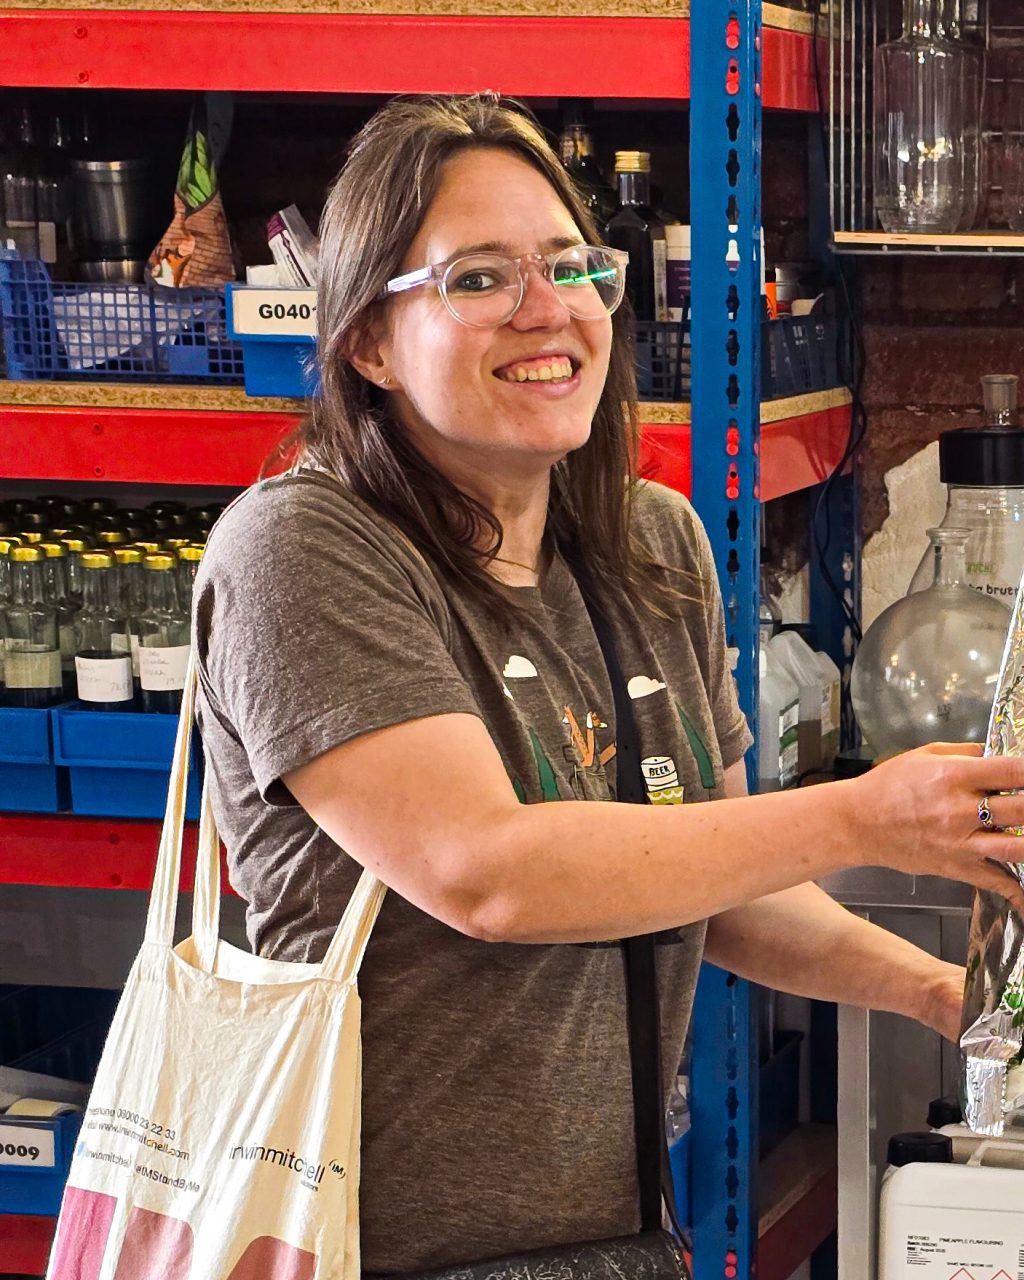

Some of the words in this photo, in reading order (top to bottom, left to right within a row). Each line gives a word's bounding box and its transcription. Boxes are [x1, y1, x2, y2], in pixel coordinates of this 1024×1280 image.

[259, 304, 316, 319] G040
[649, 765, 670, 776] BEER
[150, 1122, 164, 1136] 22
[164, 1128, 176, 1141] 33
[229, 1143, 326, 1183] irwinmitchell
